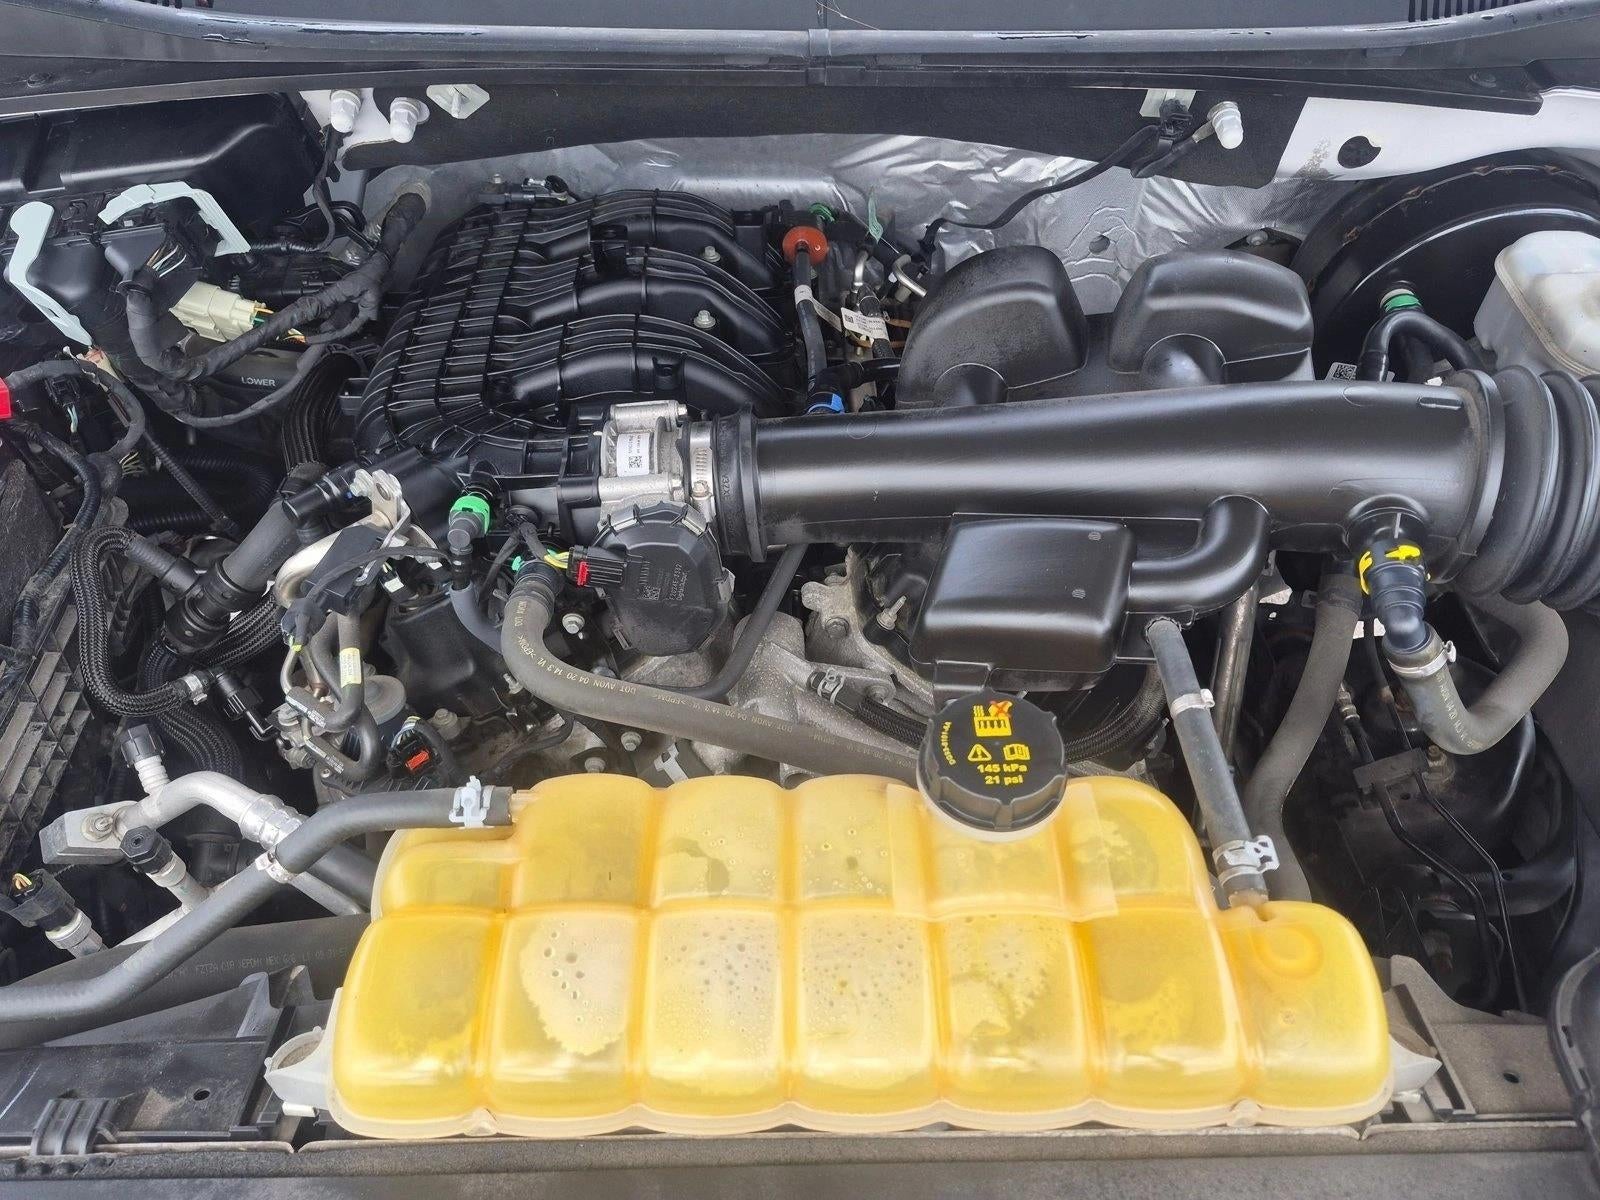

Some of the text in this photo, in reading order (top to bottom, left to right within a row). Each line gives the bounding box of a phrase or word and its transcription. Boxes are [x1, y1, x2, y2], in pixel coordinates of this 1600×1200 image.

[241, 376, 276, 387] LOWER
[566, 671, 578, 681] 20
[579, 675, 590, 684] 04
[593, 679, 616, 690] AVON
[620, 685, 637, 695] DOT
[977, 763, 1028, 773] 145 kPa
[985, 774, 1024, 786] 21 psi
